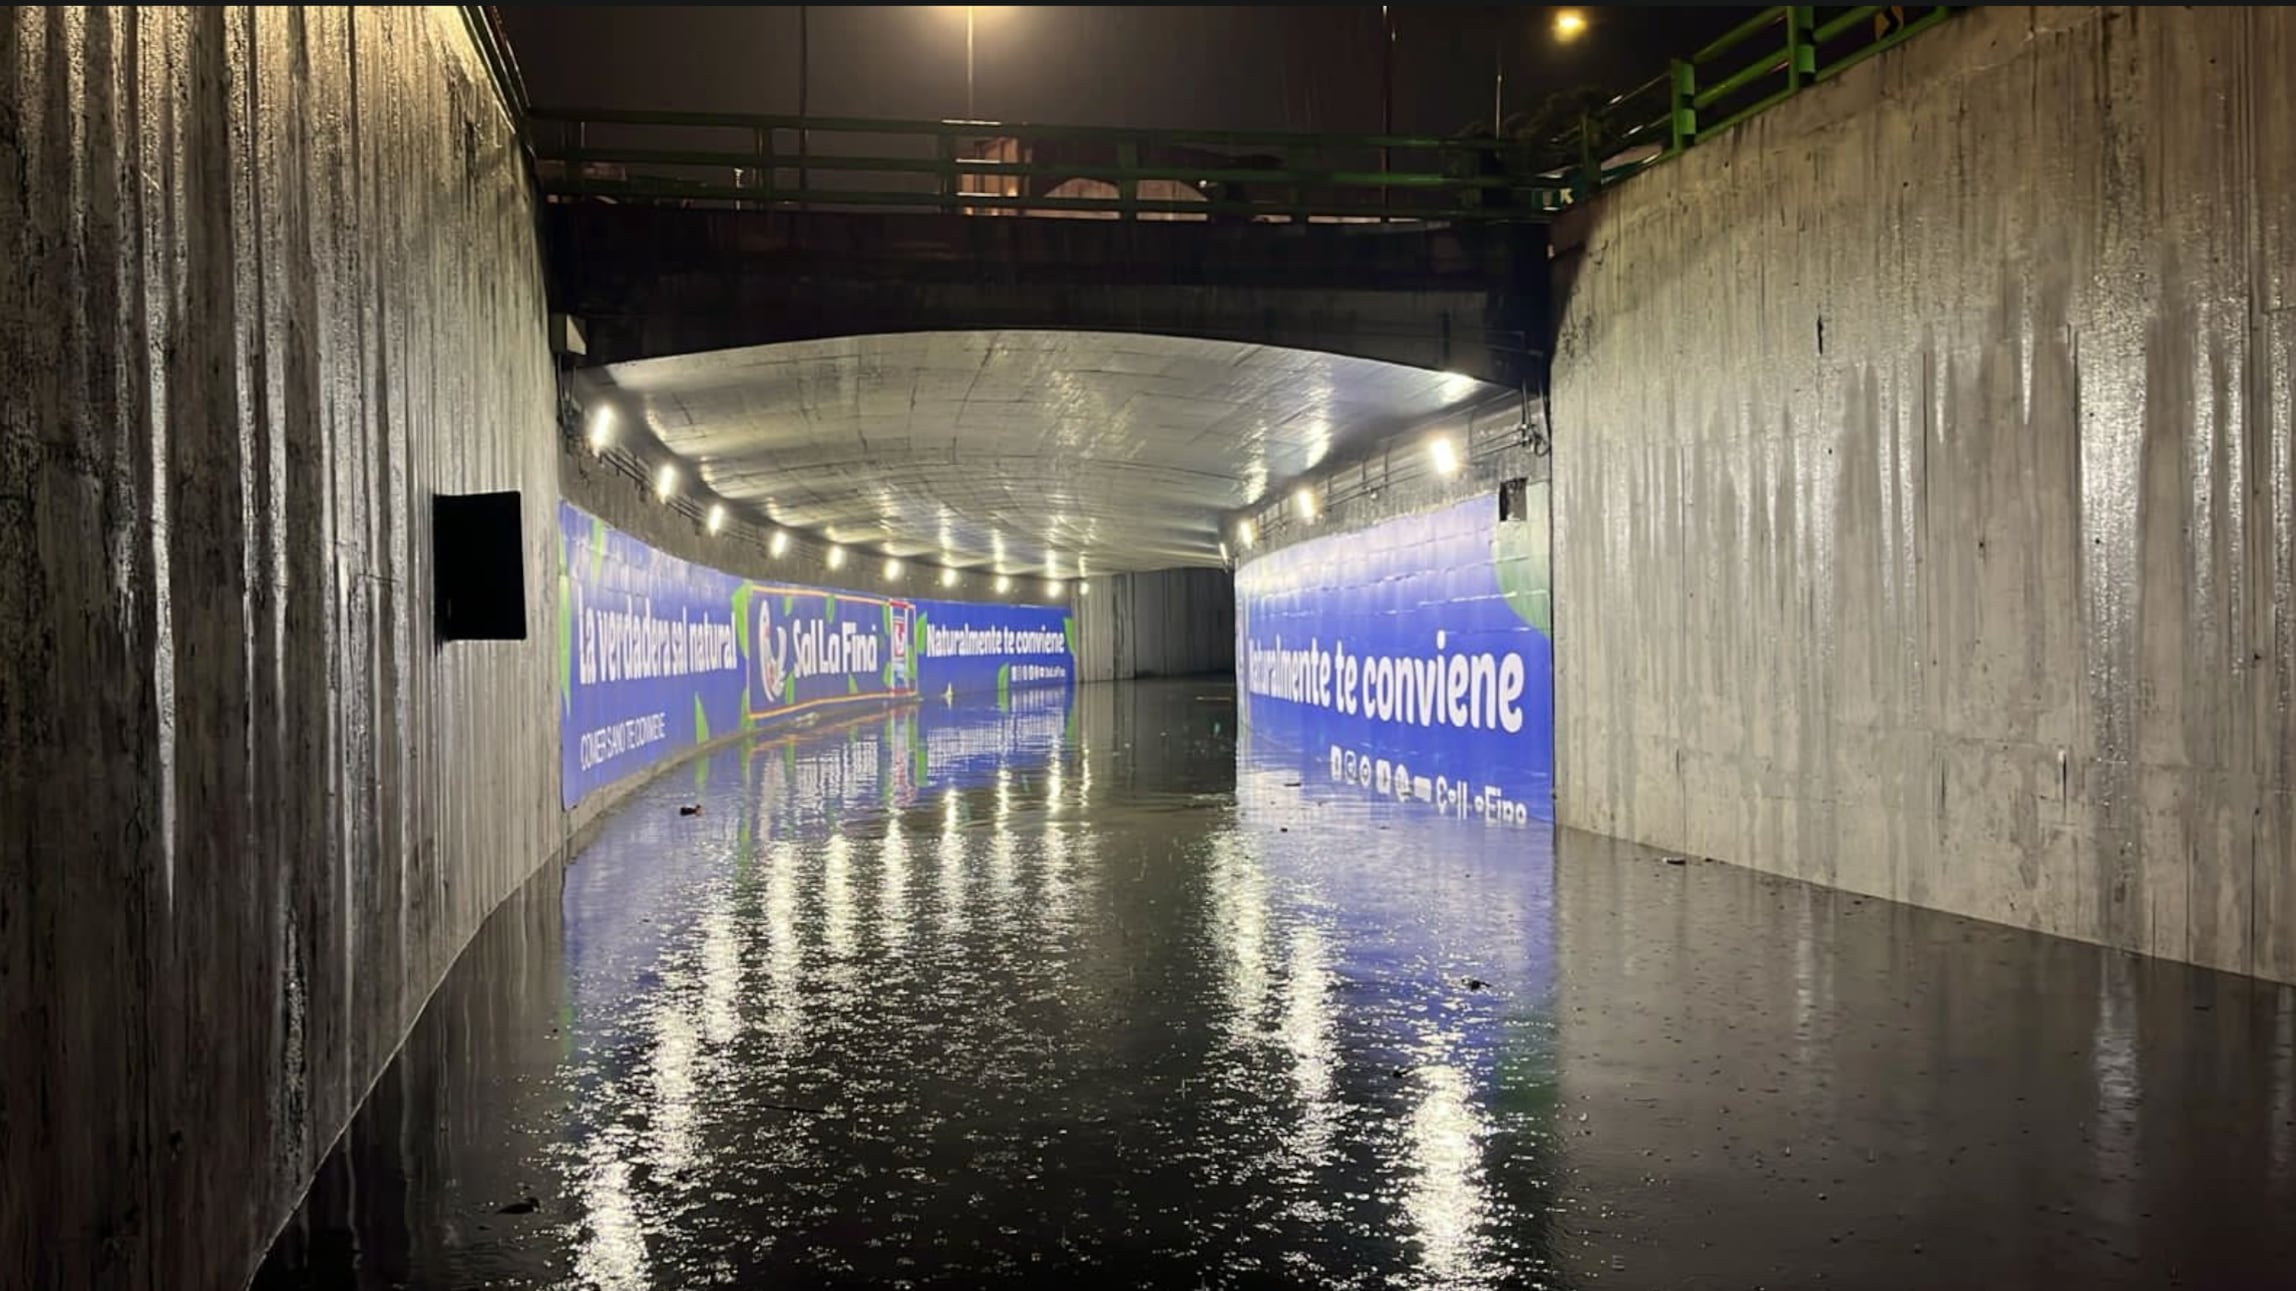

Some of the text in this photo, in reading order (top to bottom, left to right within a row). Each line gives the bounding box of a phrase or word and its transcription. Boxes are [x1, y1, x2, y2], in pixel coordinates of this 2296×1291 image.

[597, 595, 672, 683] verdadera
[672, 605, 688, 676] sal
[688, 611, 738, 673] natural
[793, 618, 817, 679] Sal
[818, 618, 841, 675] La
[926, 622, 1003, 658] Naturalmente
[1003, 625, 1015, 655] te
[1016, 624, 1065, 654] conviene
[1335, 639, 1358, 716] te
[1362, 629, 1525, 733] conviene
